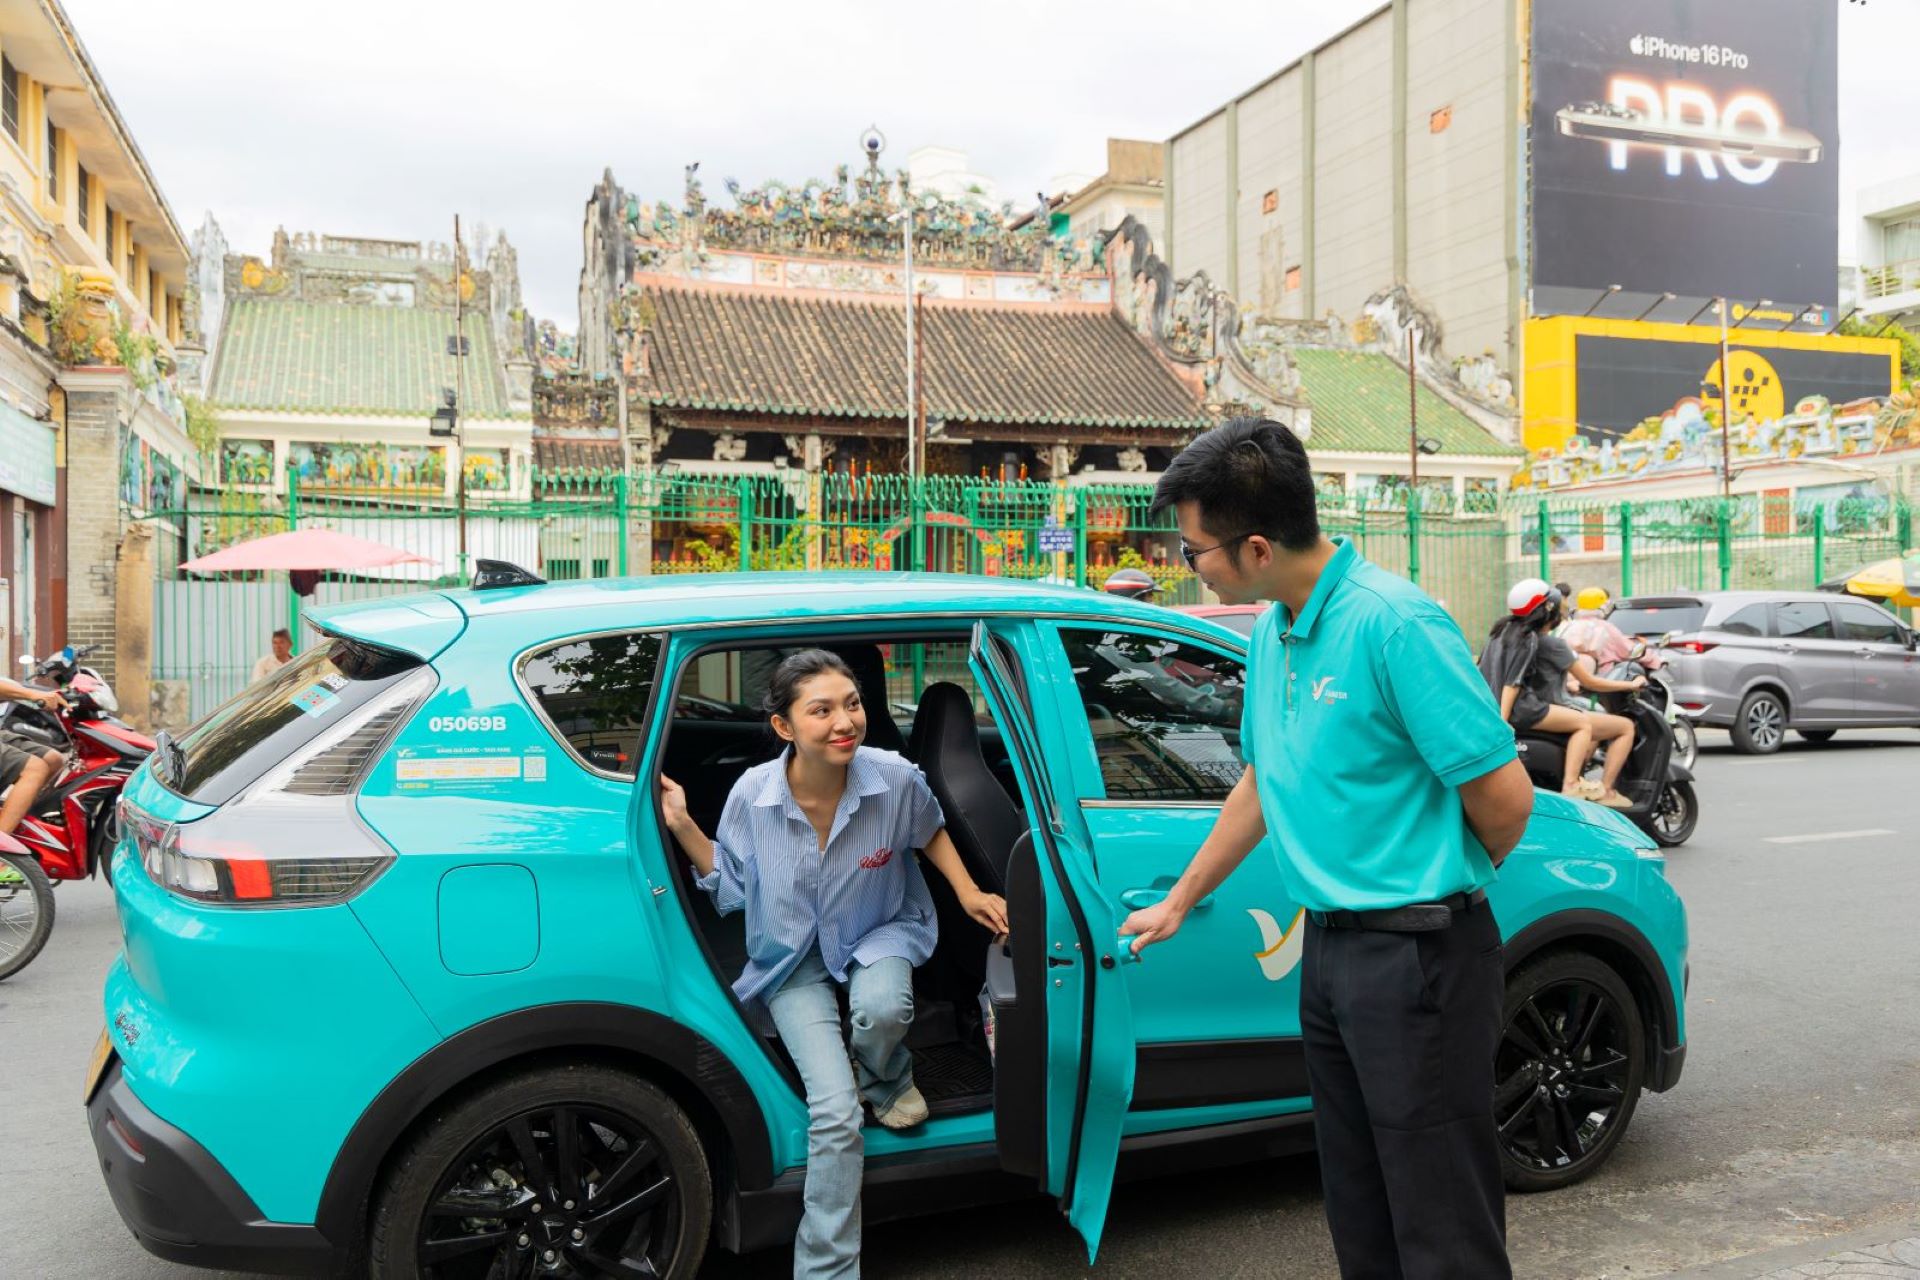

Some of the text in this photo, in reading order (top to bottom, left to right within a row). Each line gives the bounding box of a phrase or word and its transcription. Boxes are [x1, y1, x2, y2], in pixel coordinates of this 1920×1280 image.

[1644, 36, 1748, 69] iPhone 16 Pro
[1609, 76, 1780, 185] PRO
[429, 716, 506, 732] 05069B
